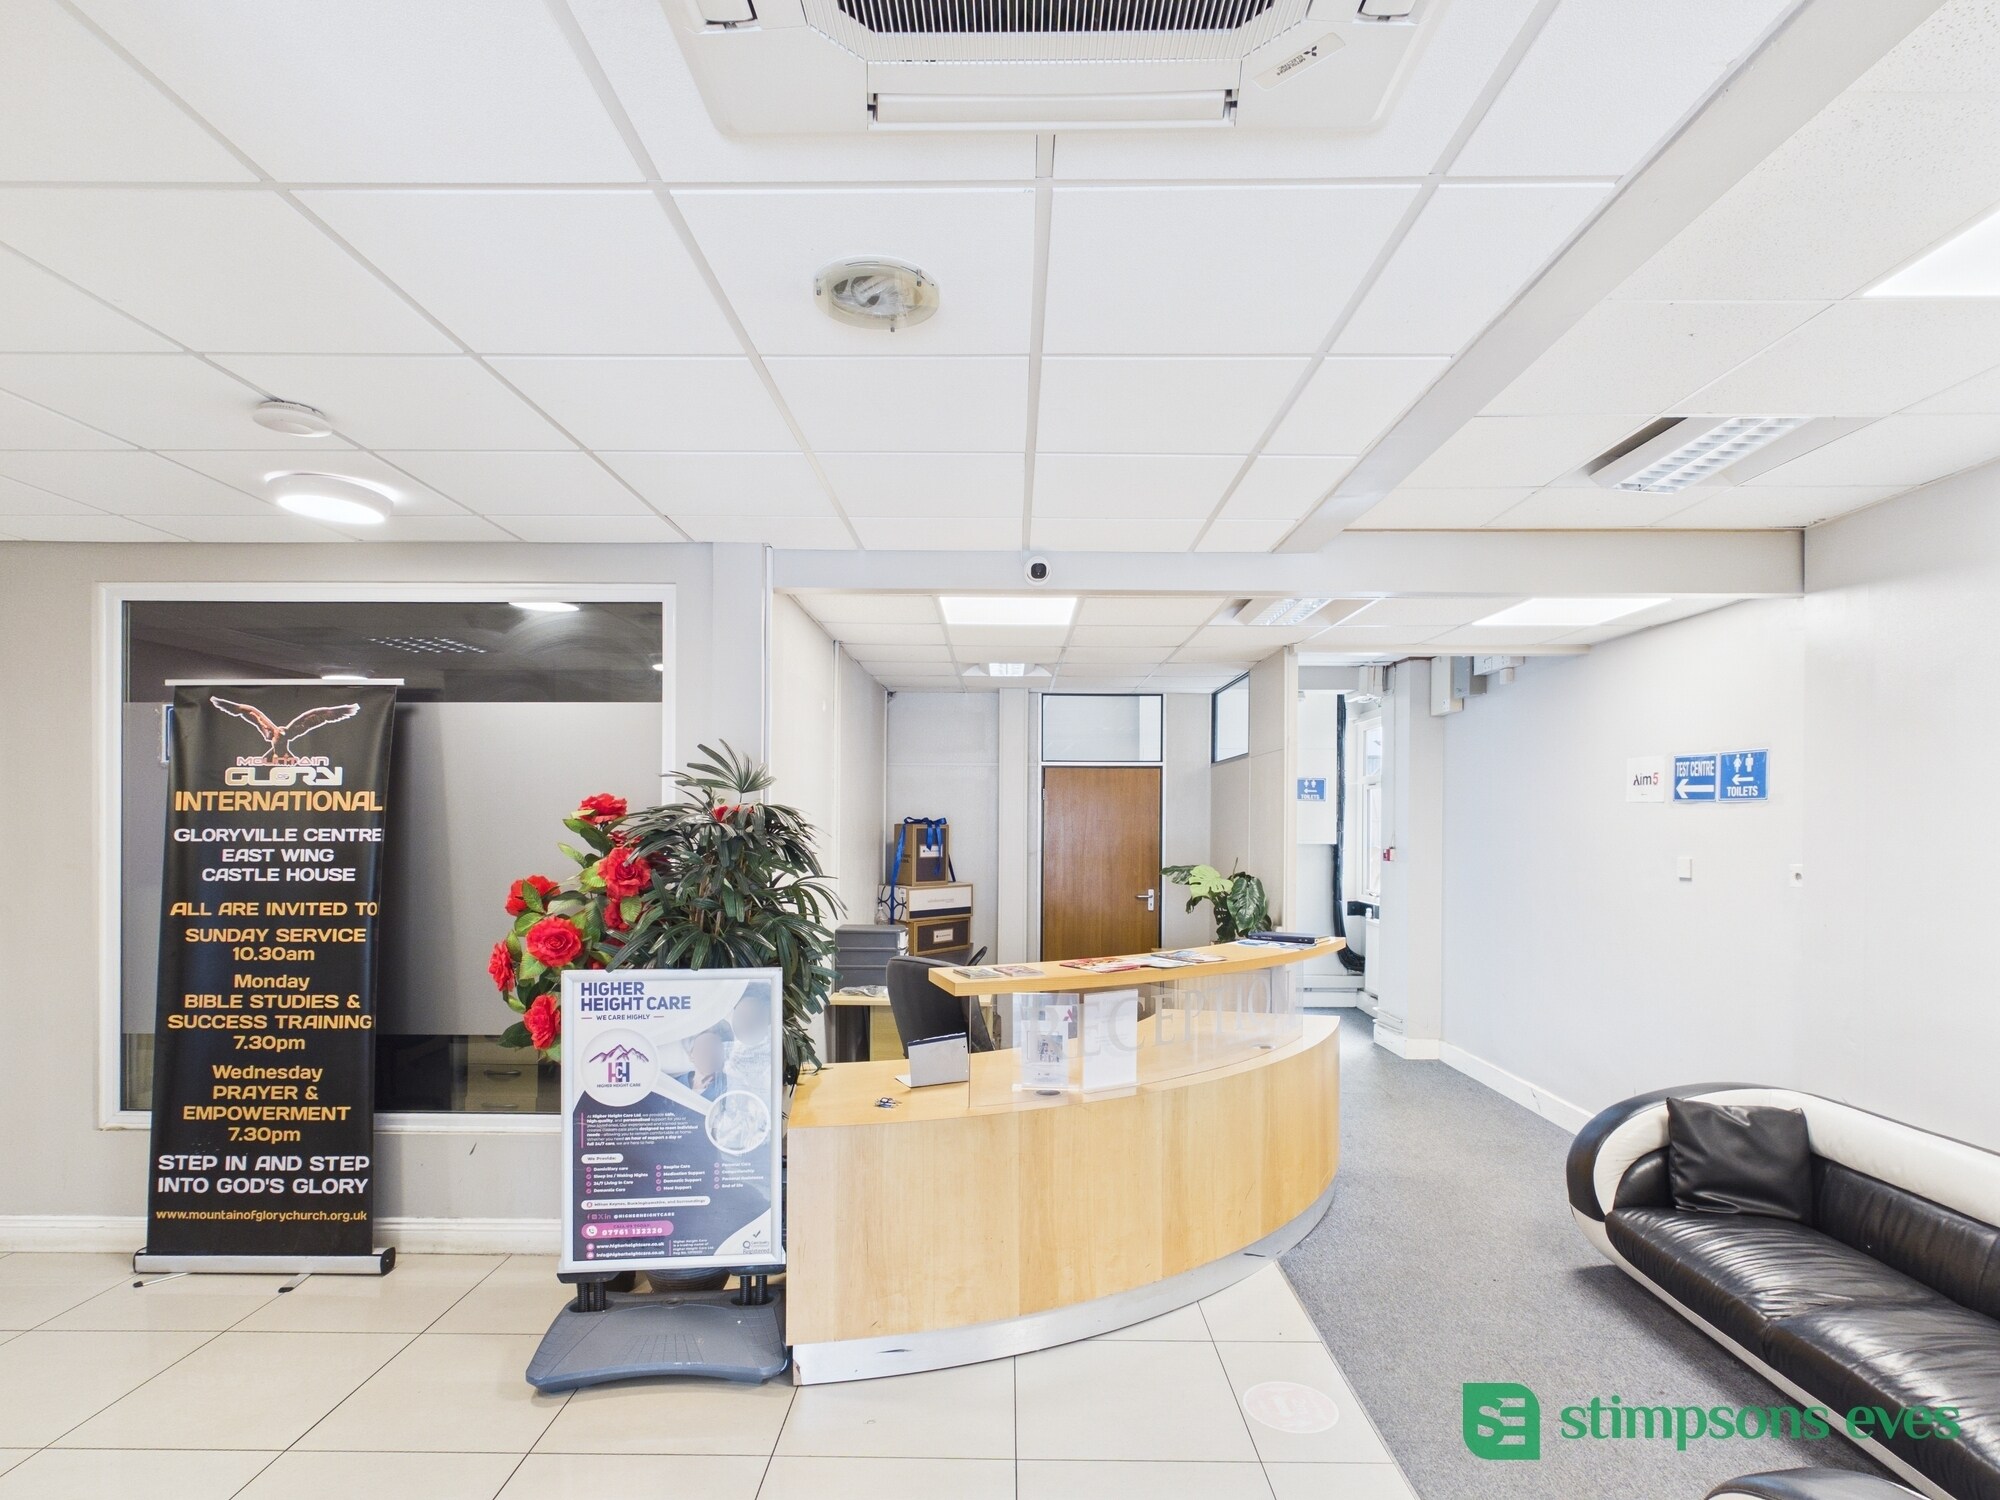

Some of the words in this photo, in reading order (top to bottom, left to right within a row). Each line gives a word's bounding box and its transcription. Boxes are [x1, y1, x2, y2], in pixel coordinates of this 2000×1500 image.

[237, 757, 328, 765] MOUNTAIN
[1676, 762, 1689, 776] TEST
[1690, 760, 1714, 775] CENTRE
[225, 767, 342, 785] GLORY
[1727, 786, 1758, 796] TOILETS
[175, 791, 382, 811] INTERNATIONAL
[174, 828, 297, 842] GLORYVILLE
[304, 828, 382, 841] CENTRE
[222, 849, 274, 862] EAST
[281, 849, 334, 862] WING
[202, 868, 279, 882] CASTLE
[286, 868, 355, 881] HOUSE
[170, 902, 211, 916] ALL
[218, 902, 259, 916] ARE
[267, 902, 347, 916] INVITED
[355, 902, 377, 916] TO
[185, 929, 269, 942] SUNDAY
[276, 928, 366, 942] SERVICE
[232, 947, 314, 961] 10.30am
[234, 975, 310, 991] Monday
[581, 982, 644, 996] HIGHER
[185, 995, 242, 1008] BIBLE
[250, 995, 339, 1008] STUDIES
[347, 995, 360, 1008] &
[581, 997, 643, 1011] HEIGHT
[647, 996, 691, 1010] CARE
[168, 1015, 267, 1029] SUCCESS
[275, 1015, 372, 1029] TRAINING
[234, 1035, 305, 1052] 7.30pm
[213, 1065, 322, 1082] Wednesday
[213, 1086, 298, 1100] PRAYER
[305, 1086, 318, 1100] &
[183, 1106, 351, 1120] EMPOWERMENT
[228, 1127, 301, 1144] 7.30pm
[158, 1155, 217, 1171] STEP
[225, 1155, 246, 1171] IN
[255, 1155, 301, 1171] AND
[310, 1155, 369, 1171] STEP
[158, 1177, 208, 1193] INTO
[217, 1177, 284, 1194] GOD'S
[293, 1178, 368, 1194] GLORY
[156, 1210, 367, 1222] www.mountainofglorychurch.org.uk
